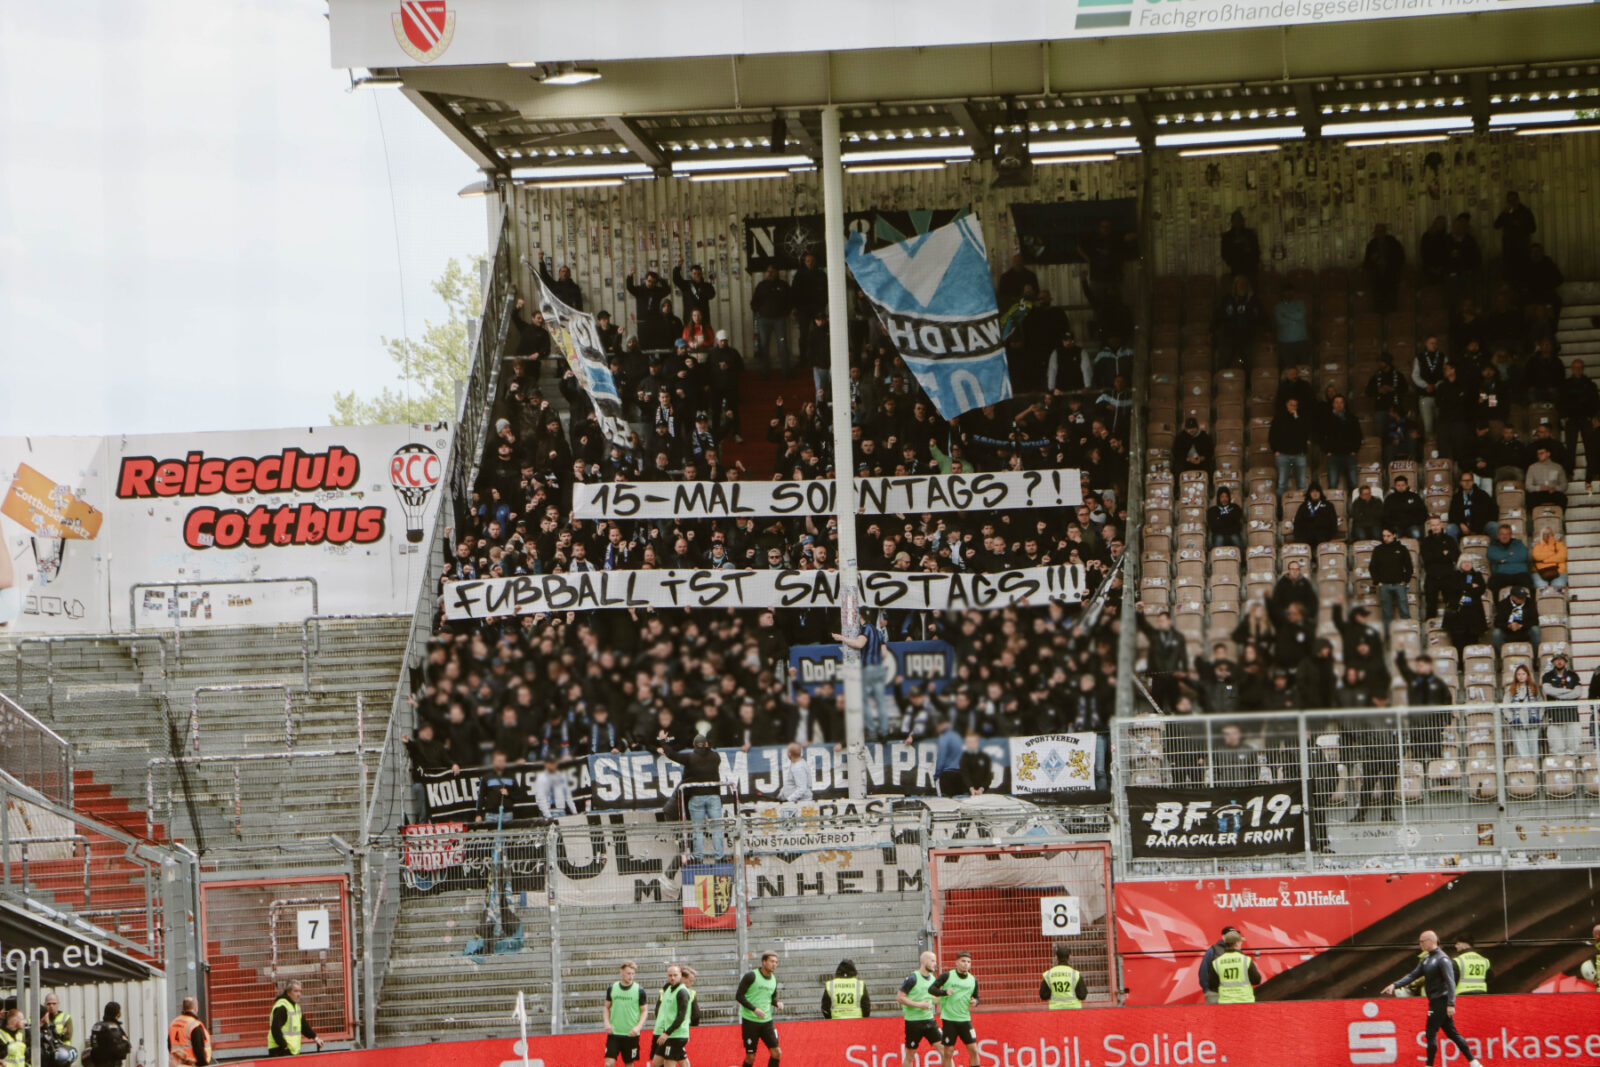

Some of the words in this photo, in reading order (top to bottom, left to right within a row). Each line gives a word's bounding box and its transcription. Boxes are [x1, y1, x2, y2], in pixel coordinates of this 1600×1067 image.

[117, 446, 360, 498] Reiseclub
[391, 455, 439, 485] RCC
[591, 483, 755, 516] 15-MAL
[184, 503, 385, 549] Cottbus
[1054, 904, 1068, 928] 8
[307, 920, 319, 940] 7
[1224, 967, 1239, 980] 477
[1469, 964, 1485, 976] 287
[836, 992, 854, 1005] 123
[1052, 981, 1071, 993] 132
[1103, 1032, 1228, 1067] Solide.
